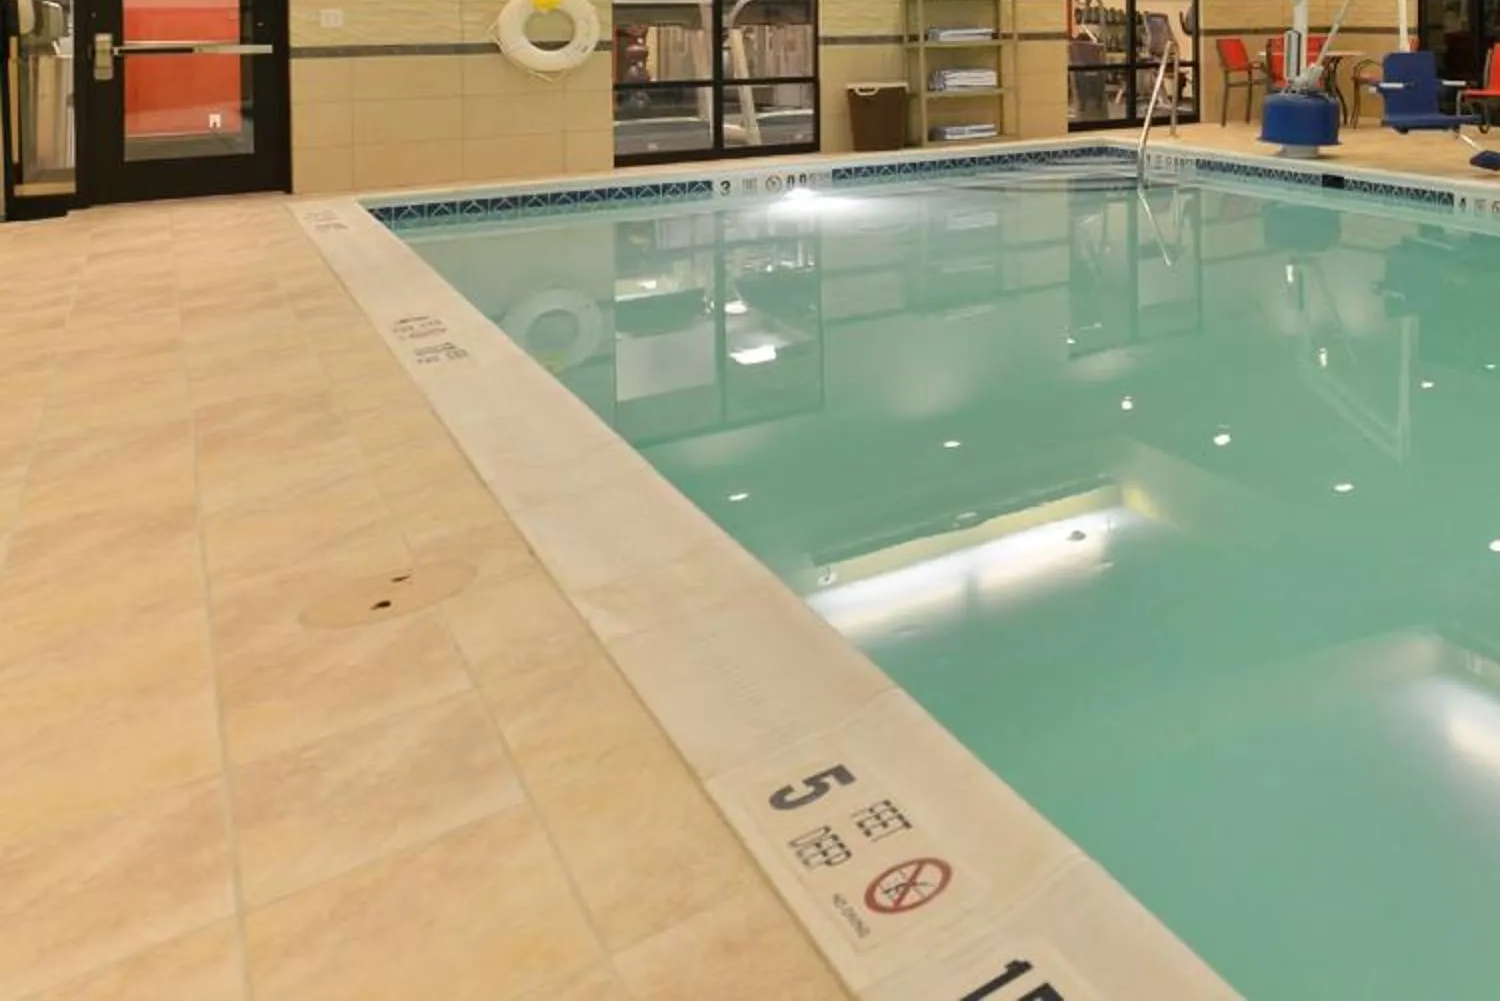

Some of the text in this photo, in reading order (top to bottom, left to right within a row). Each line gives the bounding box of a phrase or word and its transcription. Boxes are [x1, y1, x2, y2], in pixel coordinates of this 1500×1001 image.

[769, 764, 856, 811] 5
[850, 800, 913, 842] FEET
[787, 825, 853, 871] DEEP
